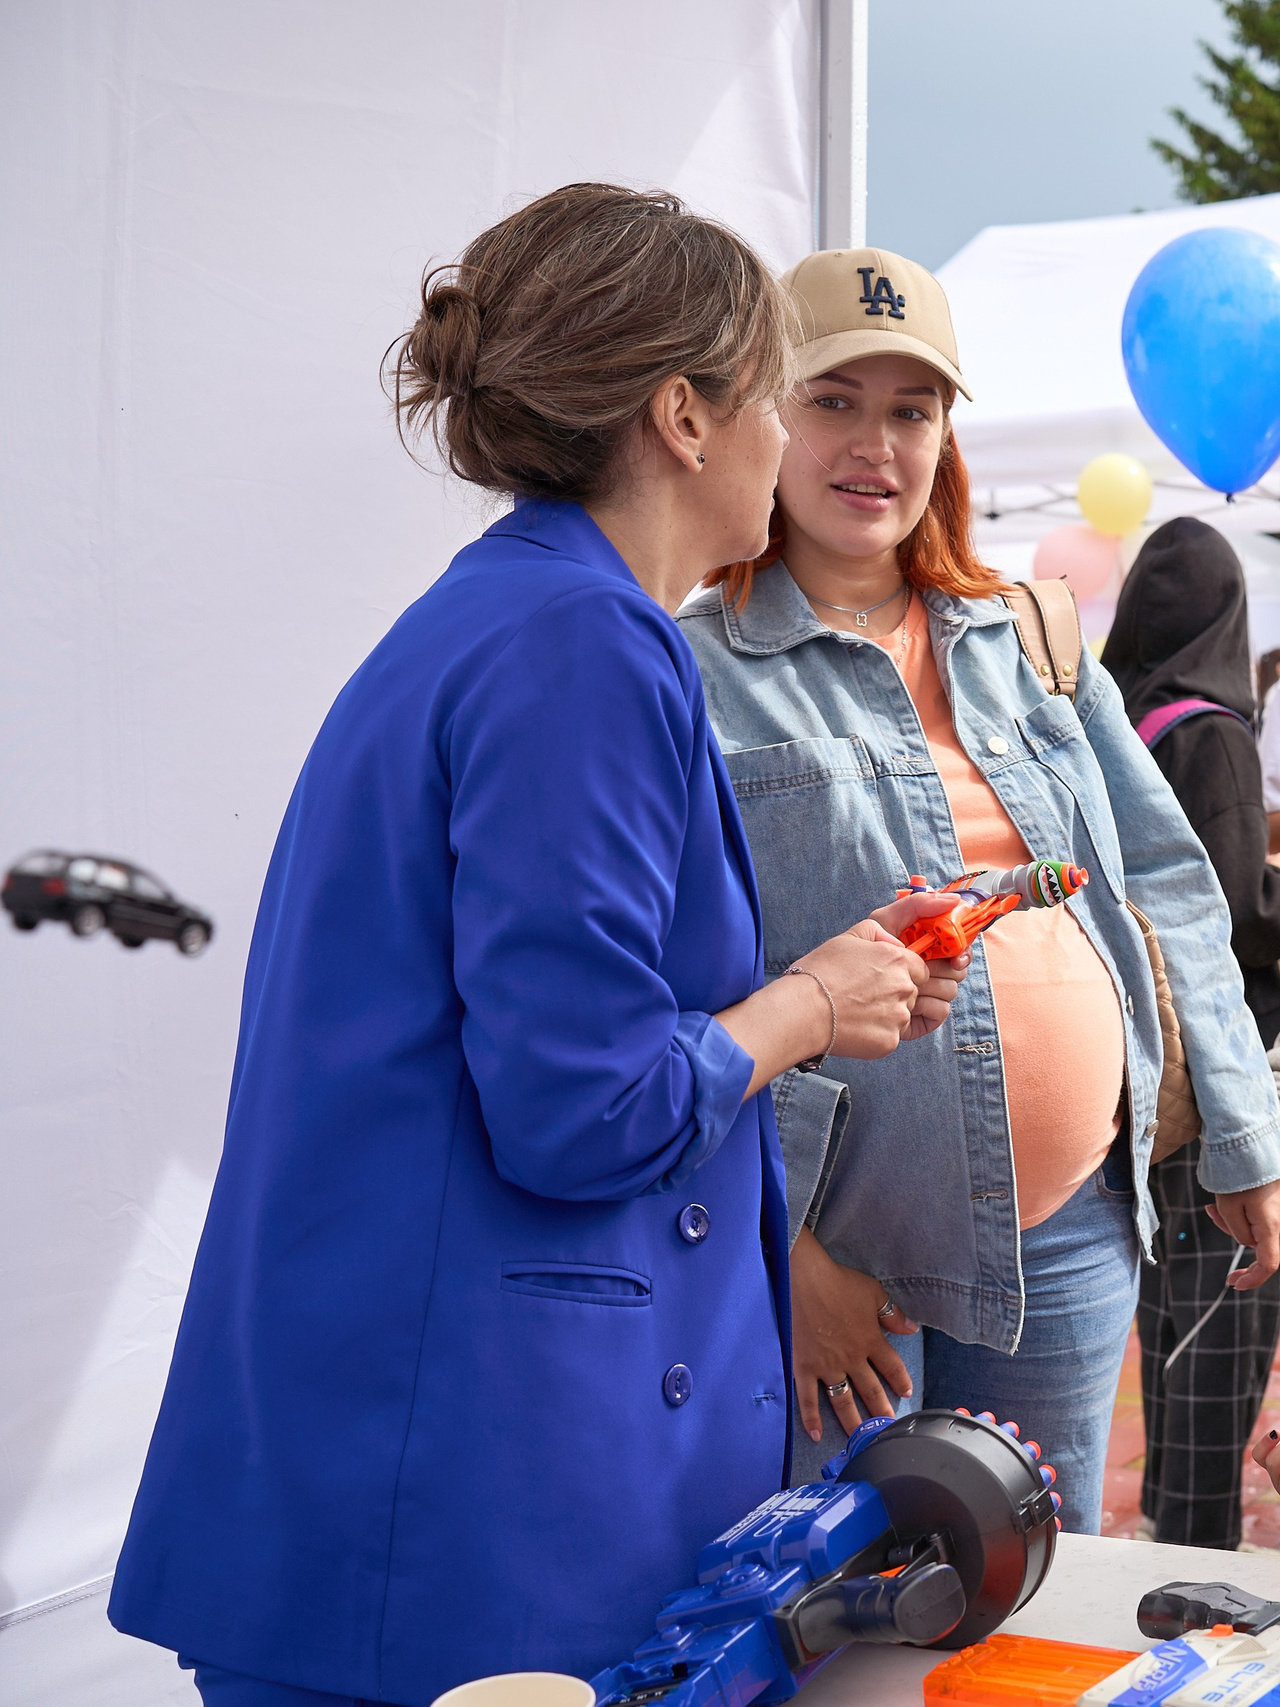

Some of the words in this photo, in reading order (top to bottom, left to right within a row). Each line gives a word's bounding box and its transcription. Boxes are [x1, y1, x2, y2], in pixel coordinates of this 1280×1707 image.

[857, 267, 905, 320] LA
[1136, 1645, 1188, 1691] NERF
[1201, 1662, 1265, 1702] ELITE
